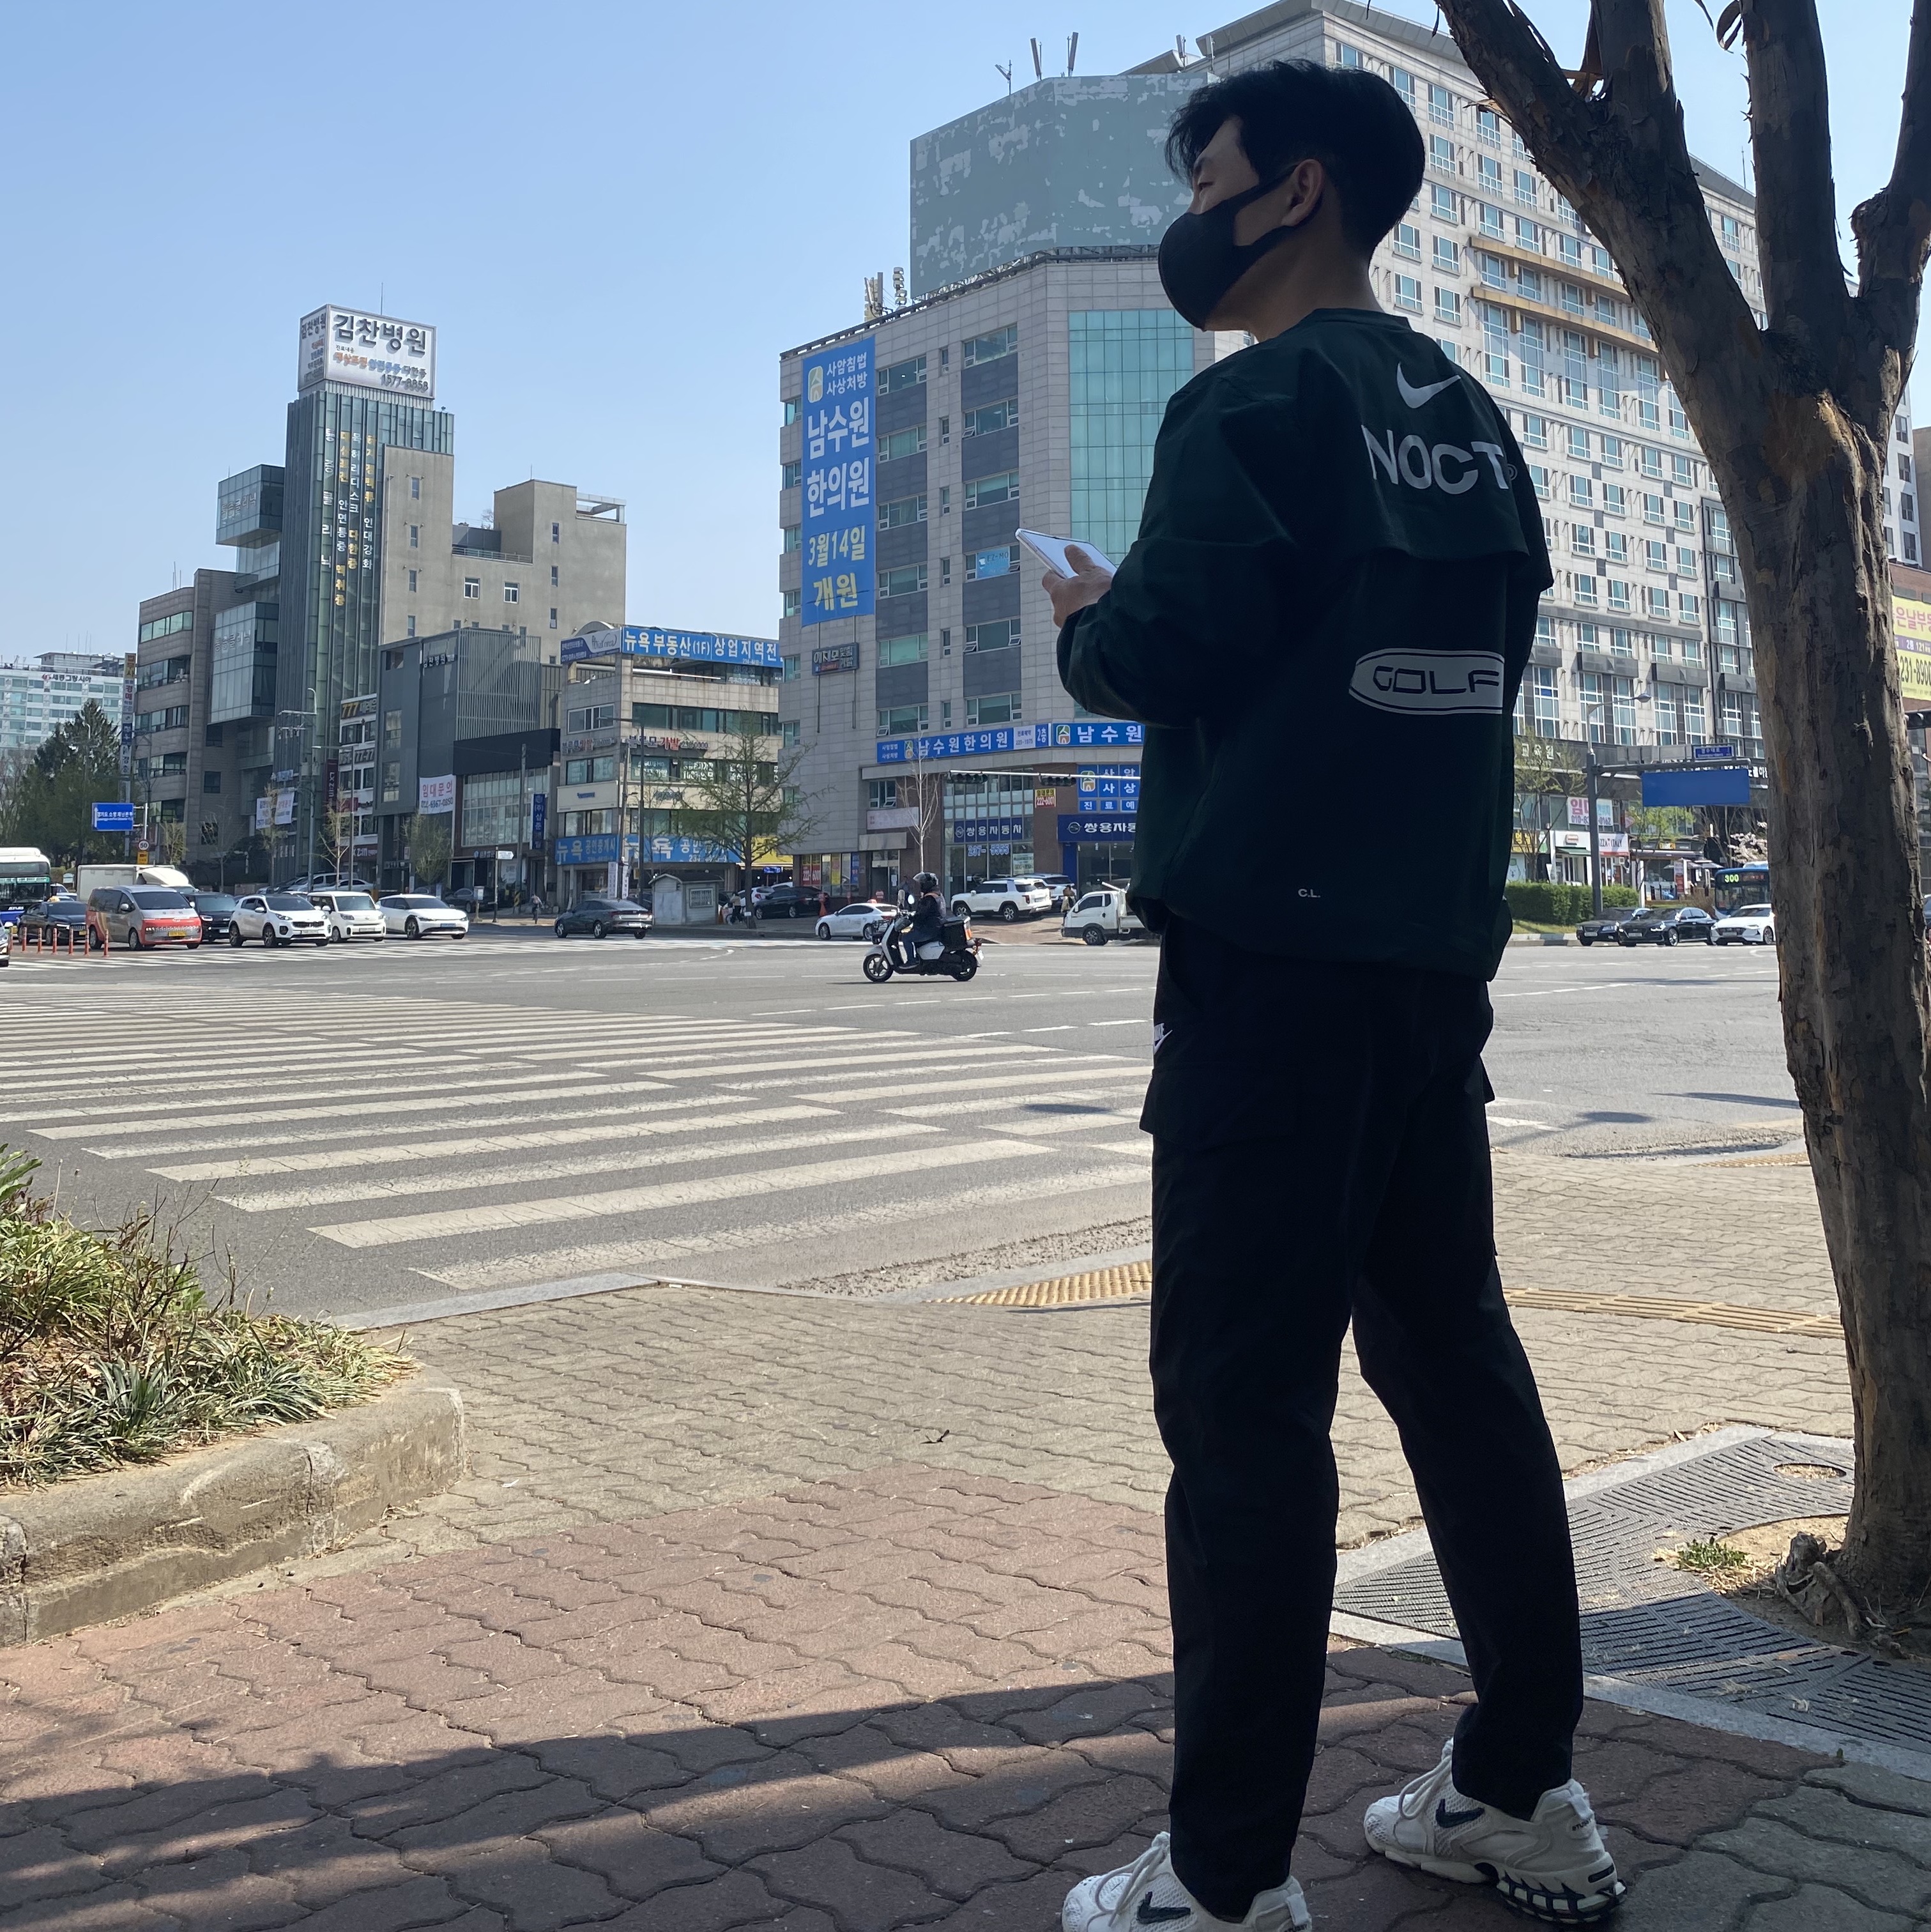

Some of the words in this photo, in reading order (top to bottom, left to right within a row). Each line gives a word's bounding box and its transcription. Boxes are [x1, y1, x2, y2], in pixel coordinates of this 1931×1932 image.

[333, 314, 426, 356] 김찬병원
[826, 351, 867, 377] 사암침법
[826, 372, 867, 396] 사상처방
[807, 397, 869, 460] 남수원
[807, 457, 869, 518] 한의원
[813, 572, 859, 611] 개원
[625, 631, 650, 653] 뉴욕
[1373, 666, 1499, 694] GOLF
[659, 737, 680, 751] 가발
[919, 731, 1008, 756] 남수원한의원
[1037, 727, 1047, 742] 2층
[1078, 725, 1142, 743] 남수원
[422, 780, 453, 798] 임대문의
[1103, 783, 1136, 794] 사상
[966, 824, 1021, 837] 쌍용자동차
[557, 840, 583, 864] 뉴욕
[1724, 874, 1739, 882] 300
[1297, 889, 1321, 898] C.L.
